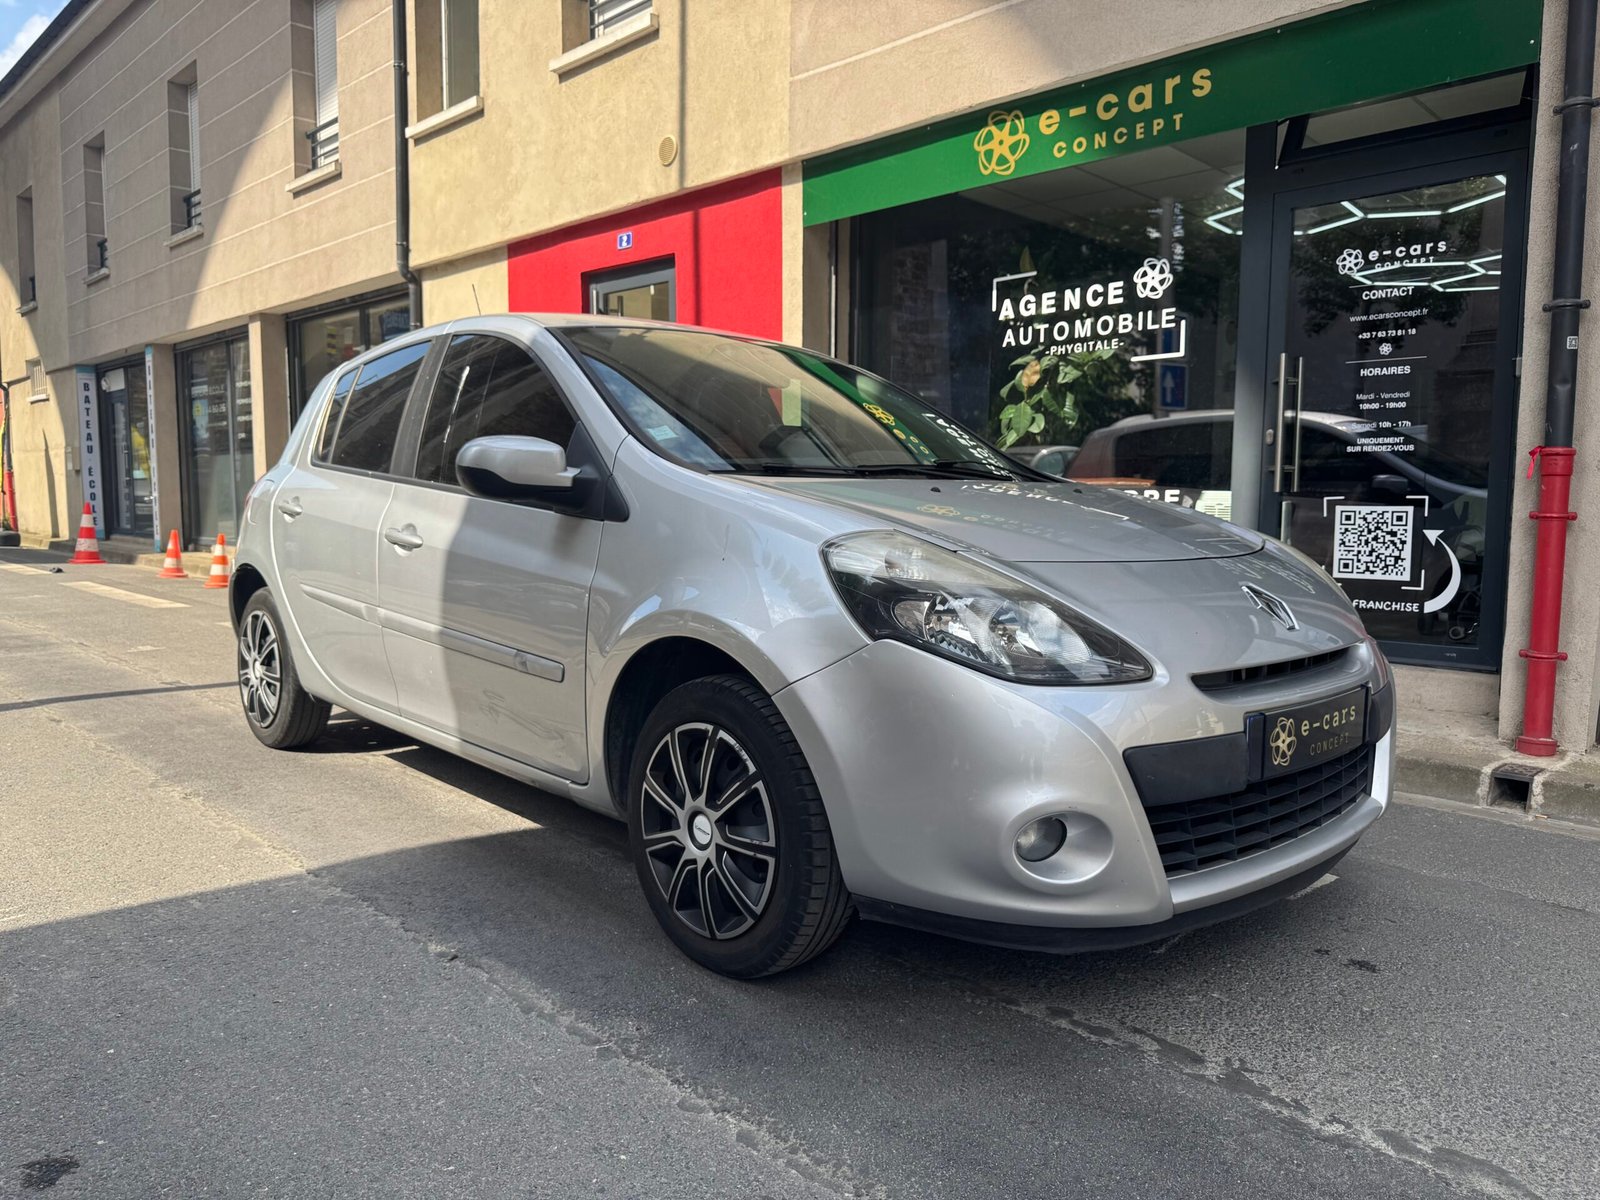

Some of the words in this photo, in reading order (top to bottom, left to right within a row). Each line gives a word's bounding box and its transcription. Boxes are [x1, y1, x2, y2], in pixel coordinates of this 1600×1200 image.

[1038, 68, 1212, 135] e-cars
[1053, 113, 1183, 158] CONCEPT
[1368, 240, 1447, 261] e-cars
[1375, 256, 1434, 270] CONCEPT
[1362, 286, 1414, 300] CONTACT
[998, 281, 1124, 321] AGENCE
[1350, 307, 1428, 322] www.ecarsconcept.fr
[1002, 307, 1176, 348] AUTOMOBILE
[1358, 331, 1371, 339] +33
[1360, 365, 1411, 377] HORAIRES
[1356, 392, 1375, 400] Mardi
[1380, 391, 1411, 399] Vendredi
[1359, 402, 1380, 410] 10h00
[1385, 401, 1407, 409] 19h00
[83, 382, 93, 455] BATEAU
[1351, 421, 1377, 430] Samedi
[1356, 436, 1405, 444] UNIQUEMENT
[1346, 445, 1361, 453] SUR
[1362, 444, 1415, 453] RENDEZ-VOUS
[1353, 599, 1420, 612] FRANCHISE
[1301, 705, 1356, 737] e-cars
[1310, 732, 1350, 756] CONCEPT
